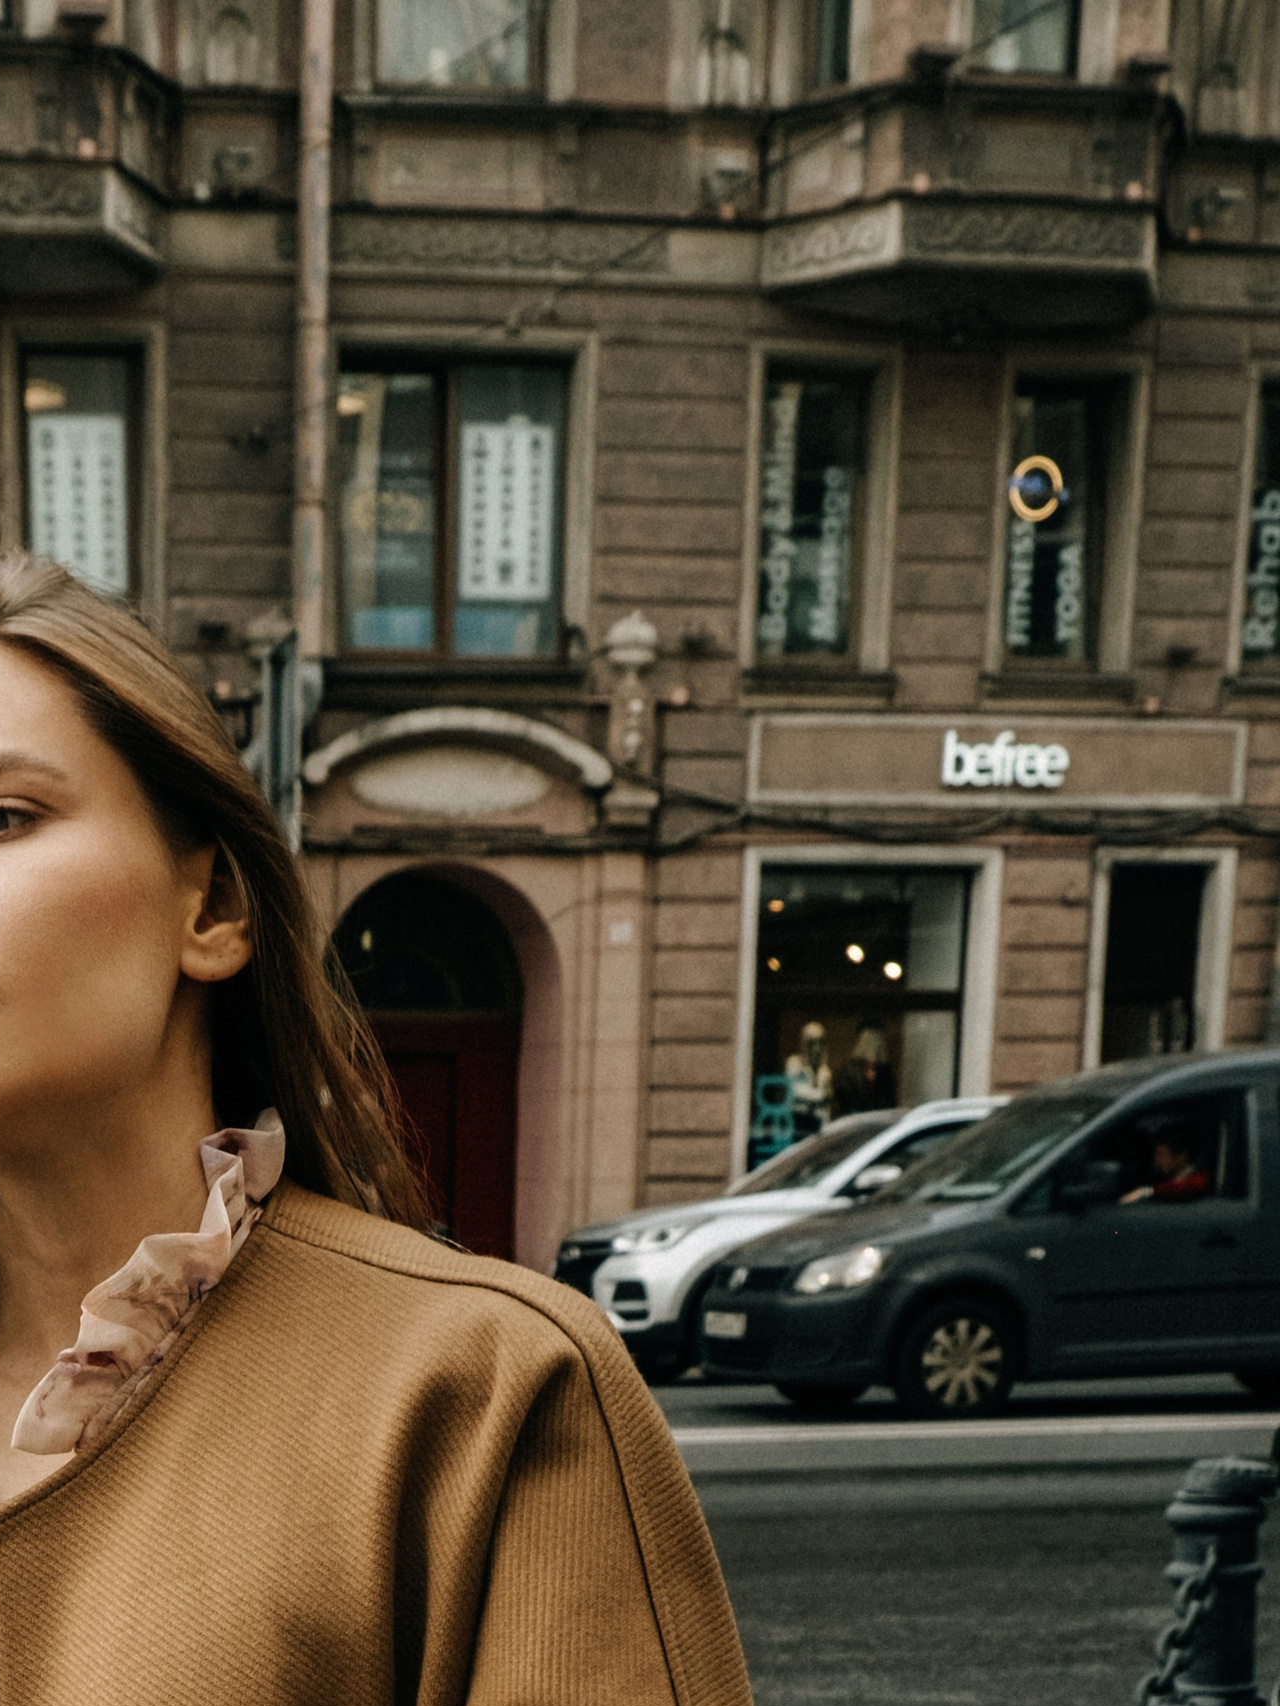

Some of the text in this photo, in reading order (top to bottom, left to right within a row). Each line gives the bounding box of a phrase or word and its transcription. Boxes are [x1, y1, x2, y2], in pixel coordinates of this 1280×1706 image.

[1006, 521, 1035, 646] FITNESS
[1056, 544, 1081, 642] YOGA
[1243, 489, 1280, 648] Rehab
[942, 729, 1070, 788] befree
